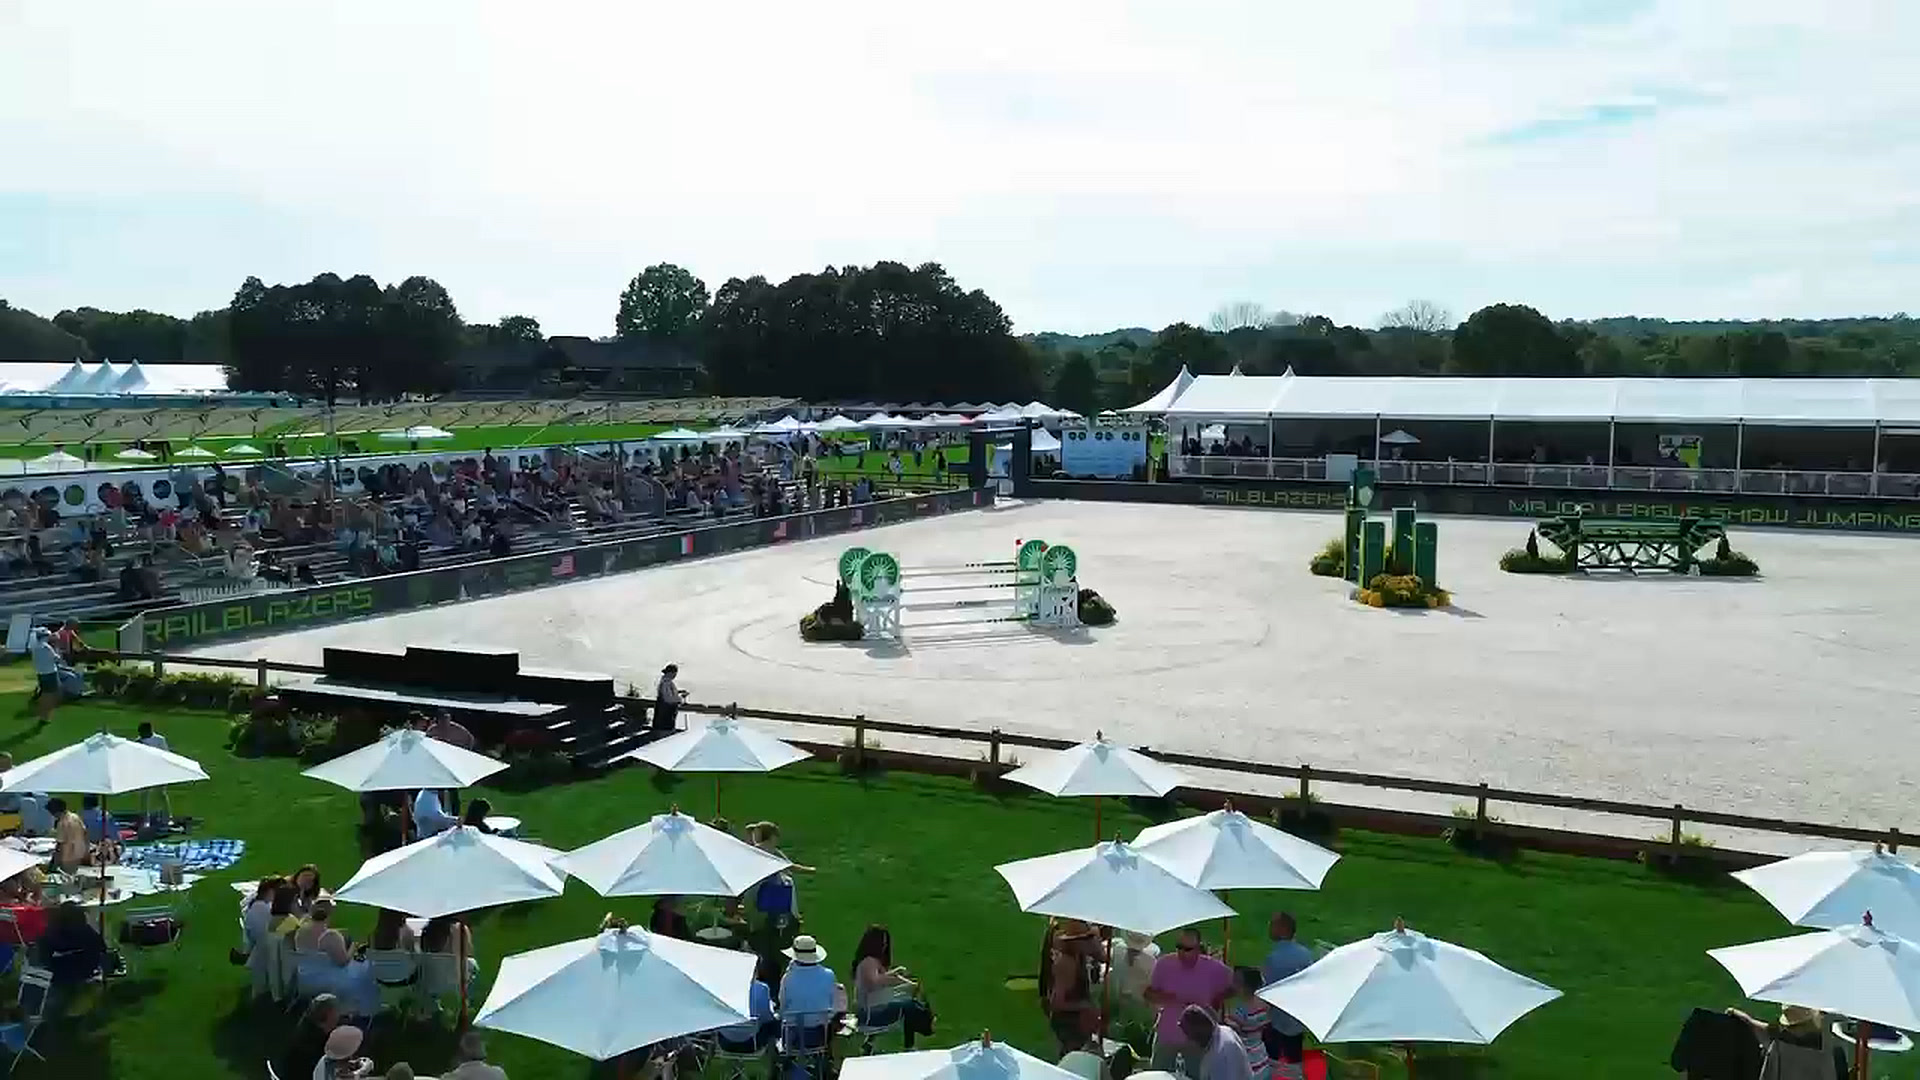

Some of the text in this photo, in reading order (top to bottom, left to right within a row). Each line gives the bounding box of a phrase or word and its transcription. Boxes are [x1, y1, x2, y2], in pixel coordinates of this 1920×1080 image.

[1508, 498, 1920, 529] MAJOR LEAGUE SHOW JUMPING
